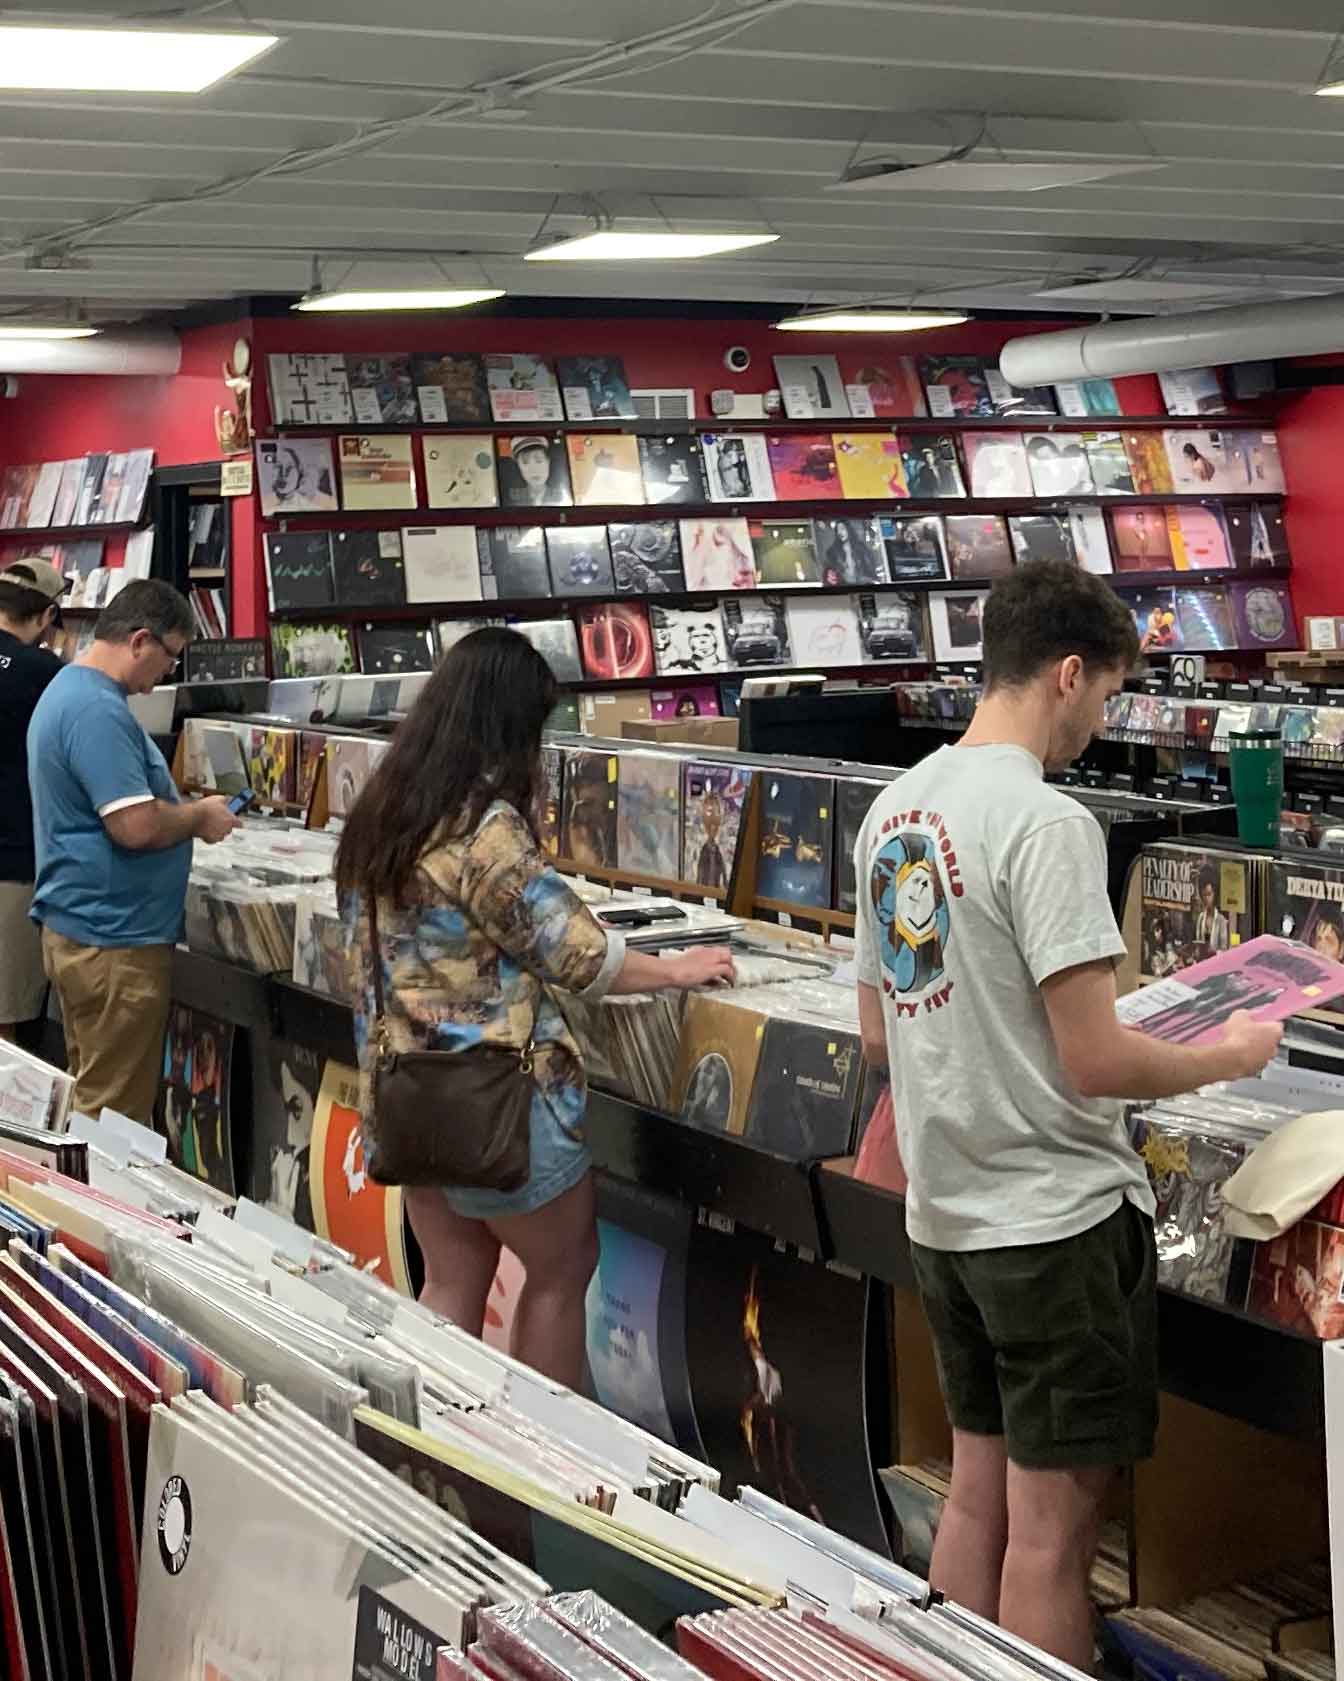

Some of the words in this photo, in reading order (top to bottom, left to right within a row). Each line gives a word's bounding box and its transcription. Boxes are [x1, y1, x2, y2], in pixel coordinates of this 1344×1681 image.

[1143, 856, 1177, 881] PENALTY
[1177, 861, 1193, 882] OF
[1143, 876, 1195, 903] LEADERSHIP
[376, 1604, 433, 1667] WALLOWS
[382, 1638, 422, 1681] MODEL
